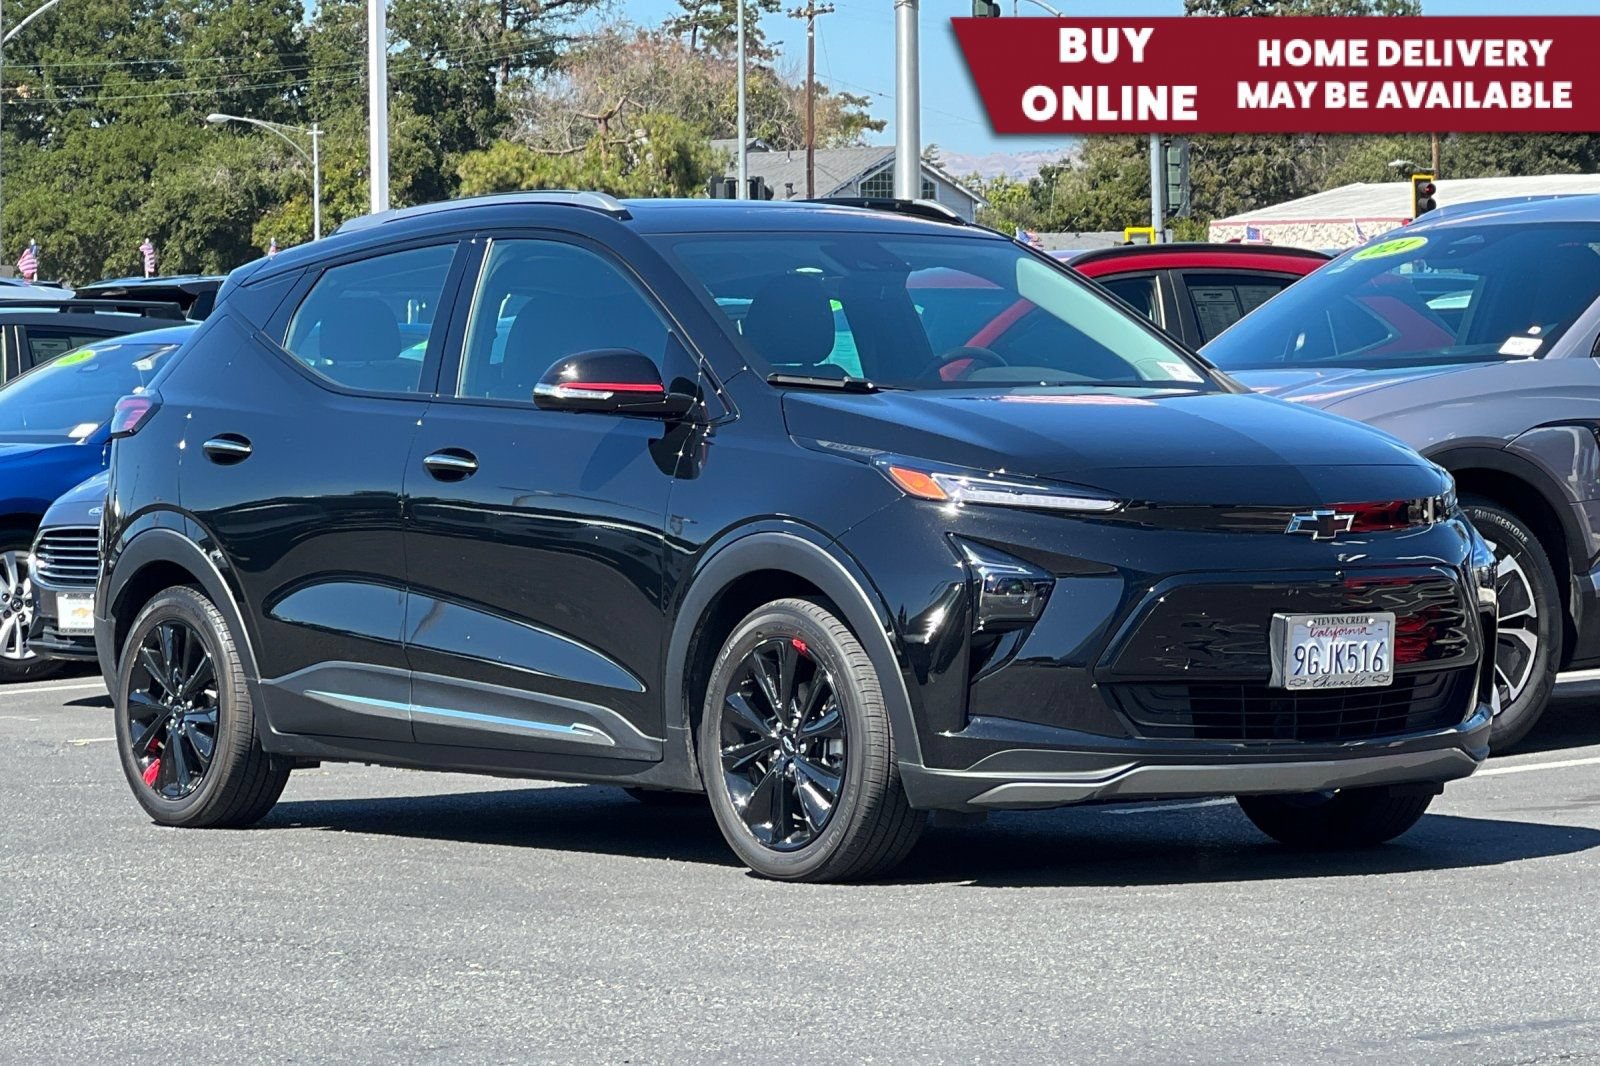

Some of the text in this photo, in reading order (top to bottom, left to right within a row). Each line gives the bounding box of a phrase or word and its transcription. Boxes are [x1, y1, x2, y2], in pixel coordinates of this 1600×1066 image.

[1474, 508, 1530, 545] BRIDGESTONE
[1313, 615, 1370, 626] STEVENS CREEK
[1310, 626, 1373, 641] California
[1293, 641, 1385, 676] 9GJK516
